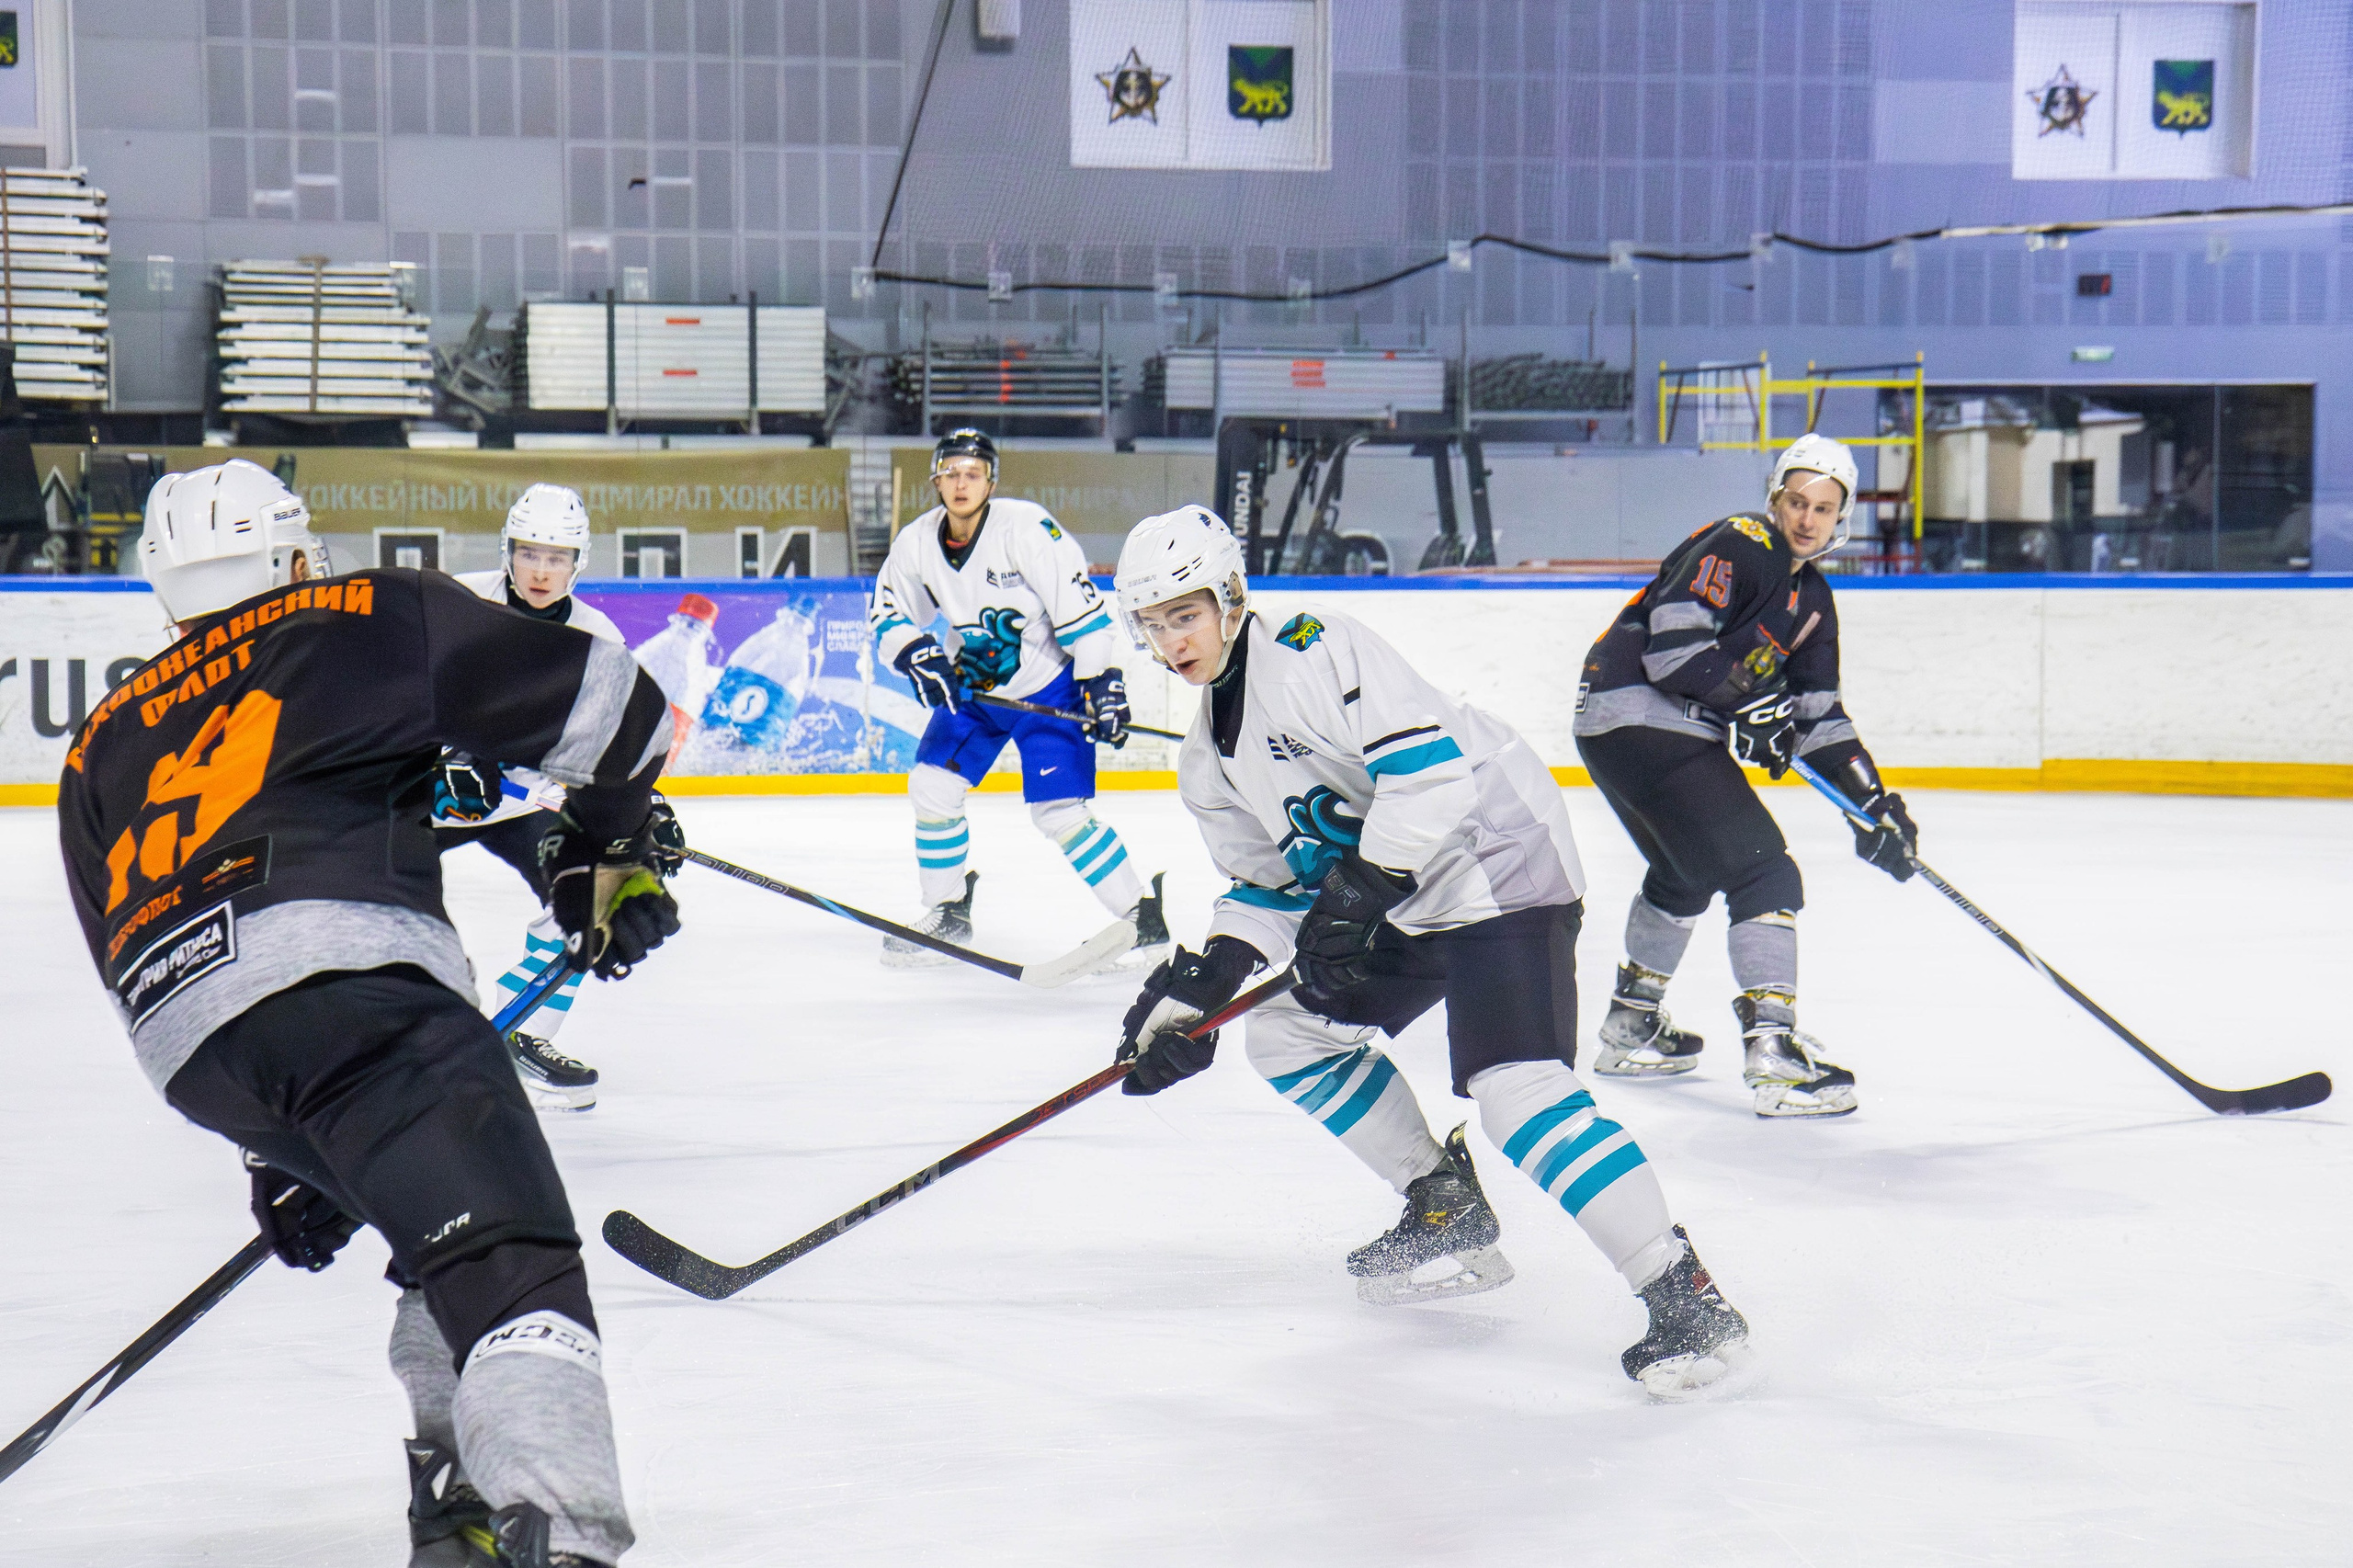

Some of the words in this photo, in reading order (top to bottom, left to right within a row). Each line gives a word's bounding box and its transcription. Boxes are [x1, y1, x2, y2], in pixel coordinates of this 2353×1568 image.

[586, 483, 711, 515] ДМИРАЛ
[1233, 472, 1252, 562] UNDAI
[1689, 554, 1732, 608] 15
[140, 640, 256, 727] ФЛОТ
[836, 1161, 940, 1233] CCM
